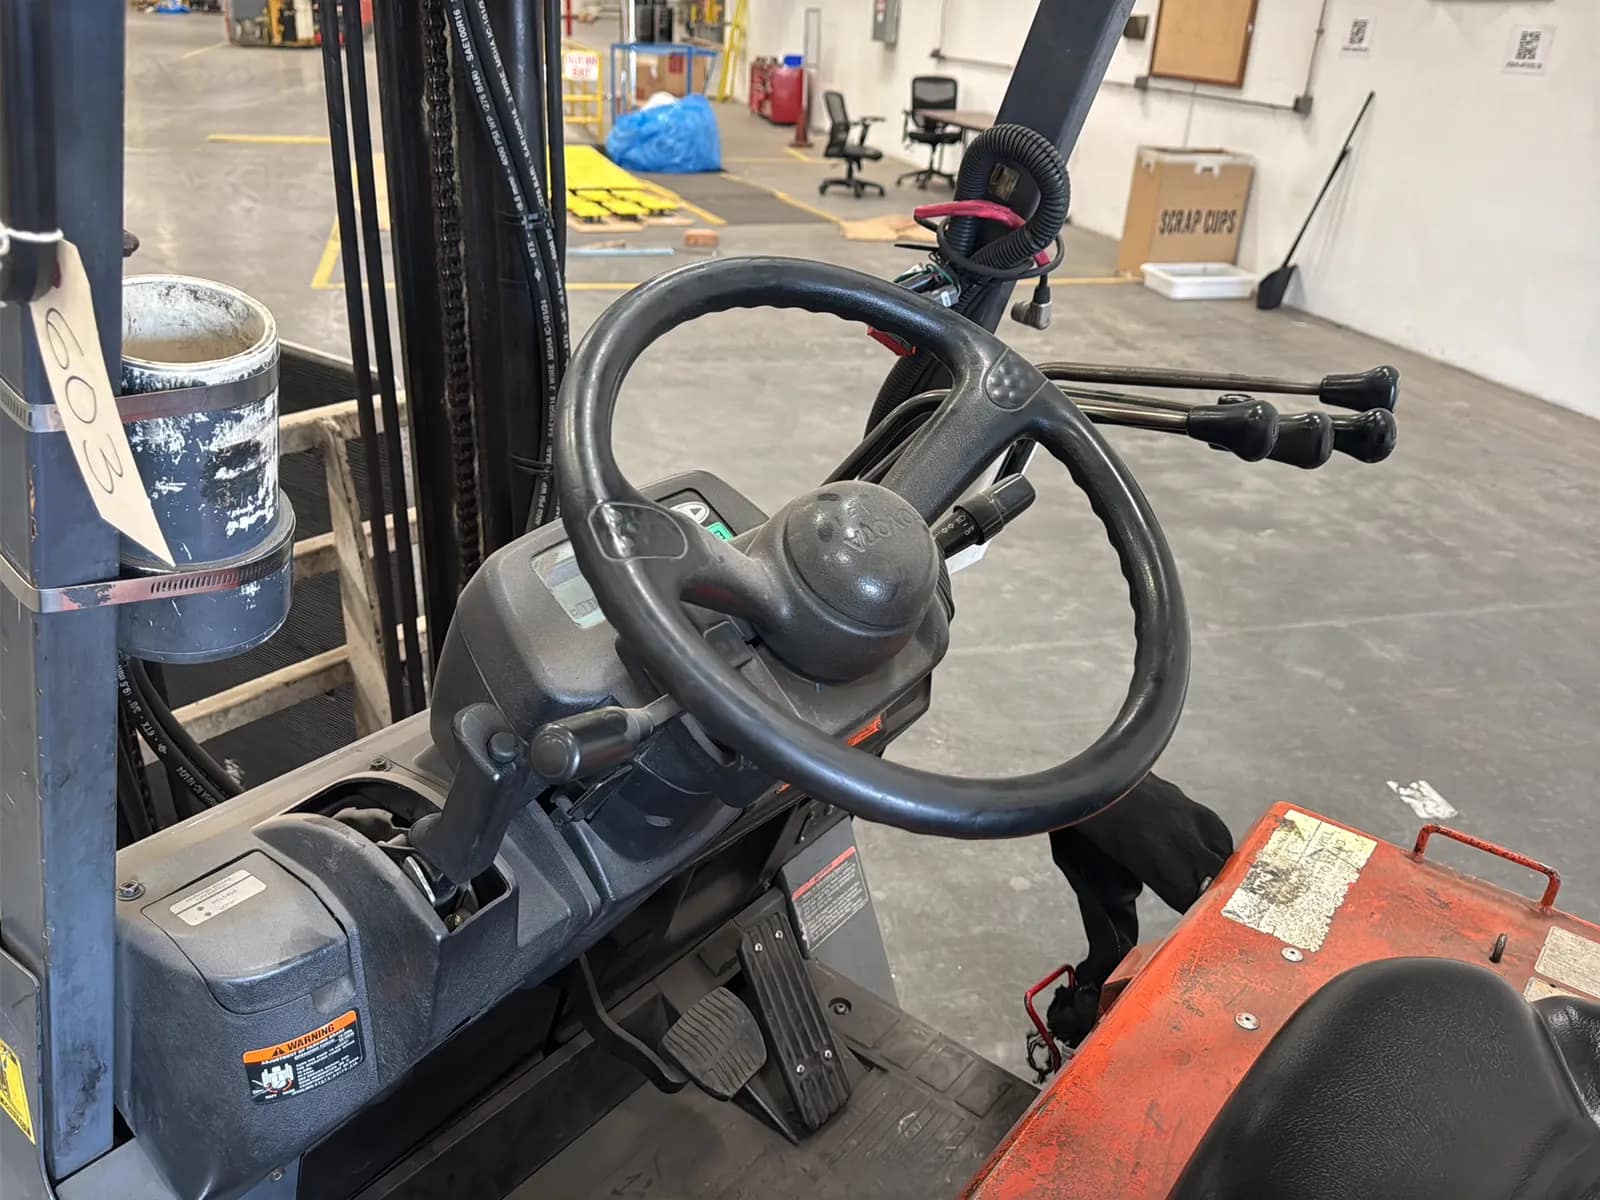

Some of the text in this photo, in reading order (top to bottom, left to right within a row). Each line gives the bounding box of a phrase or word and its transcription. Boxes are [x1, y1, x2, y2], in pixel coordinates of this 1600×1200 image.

[453, 8, 474, 62] SAE100R16
[1159, 209, 1237, 235] SCRAP CUPS
[45, 307, 123, 496] 603
[286, 1023, 335, 1050] WARNING
